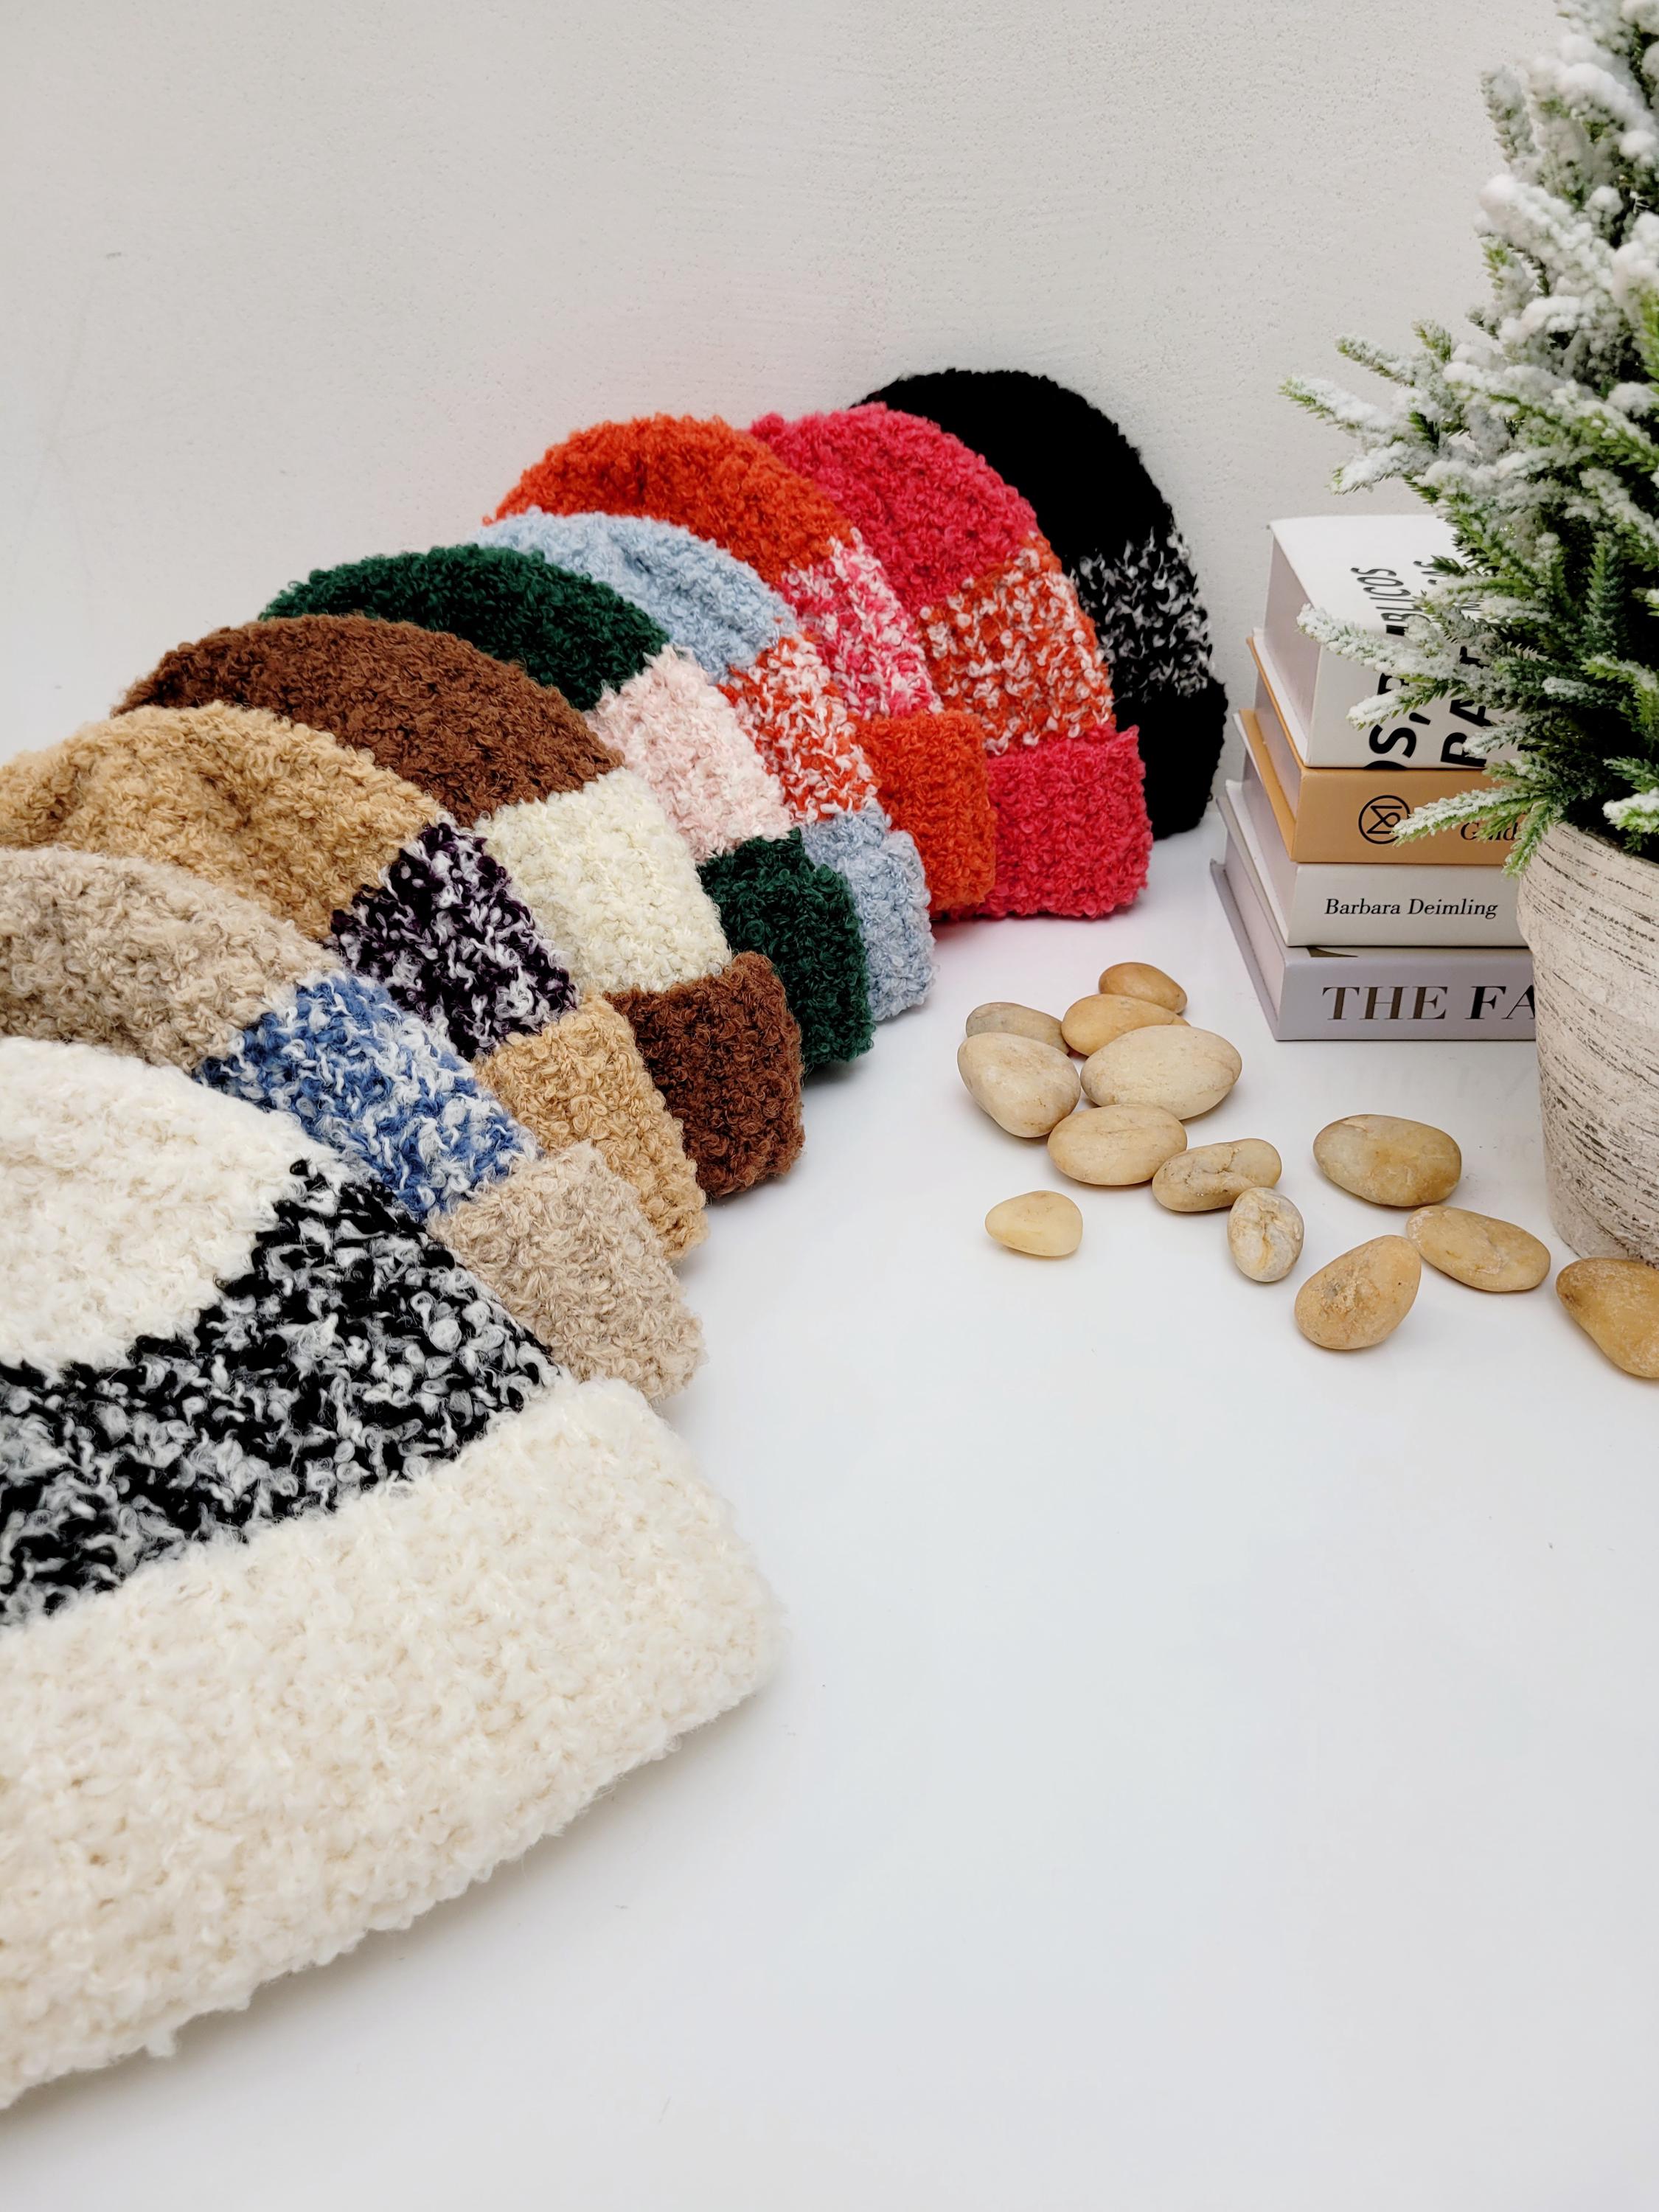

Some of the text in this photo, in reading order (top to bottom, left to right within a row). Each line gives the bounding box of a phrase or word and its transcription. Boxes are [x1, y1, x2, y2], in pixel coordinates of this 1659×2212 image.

[1324, 898, 1498, 919] Barbara Deimling
[1322, 984, 1535, 1020] THE FA
